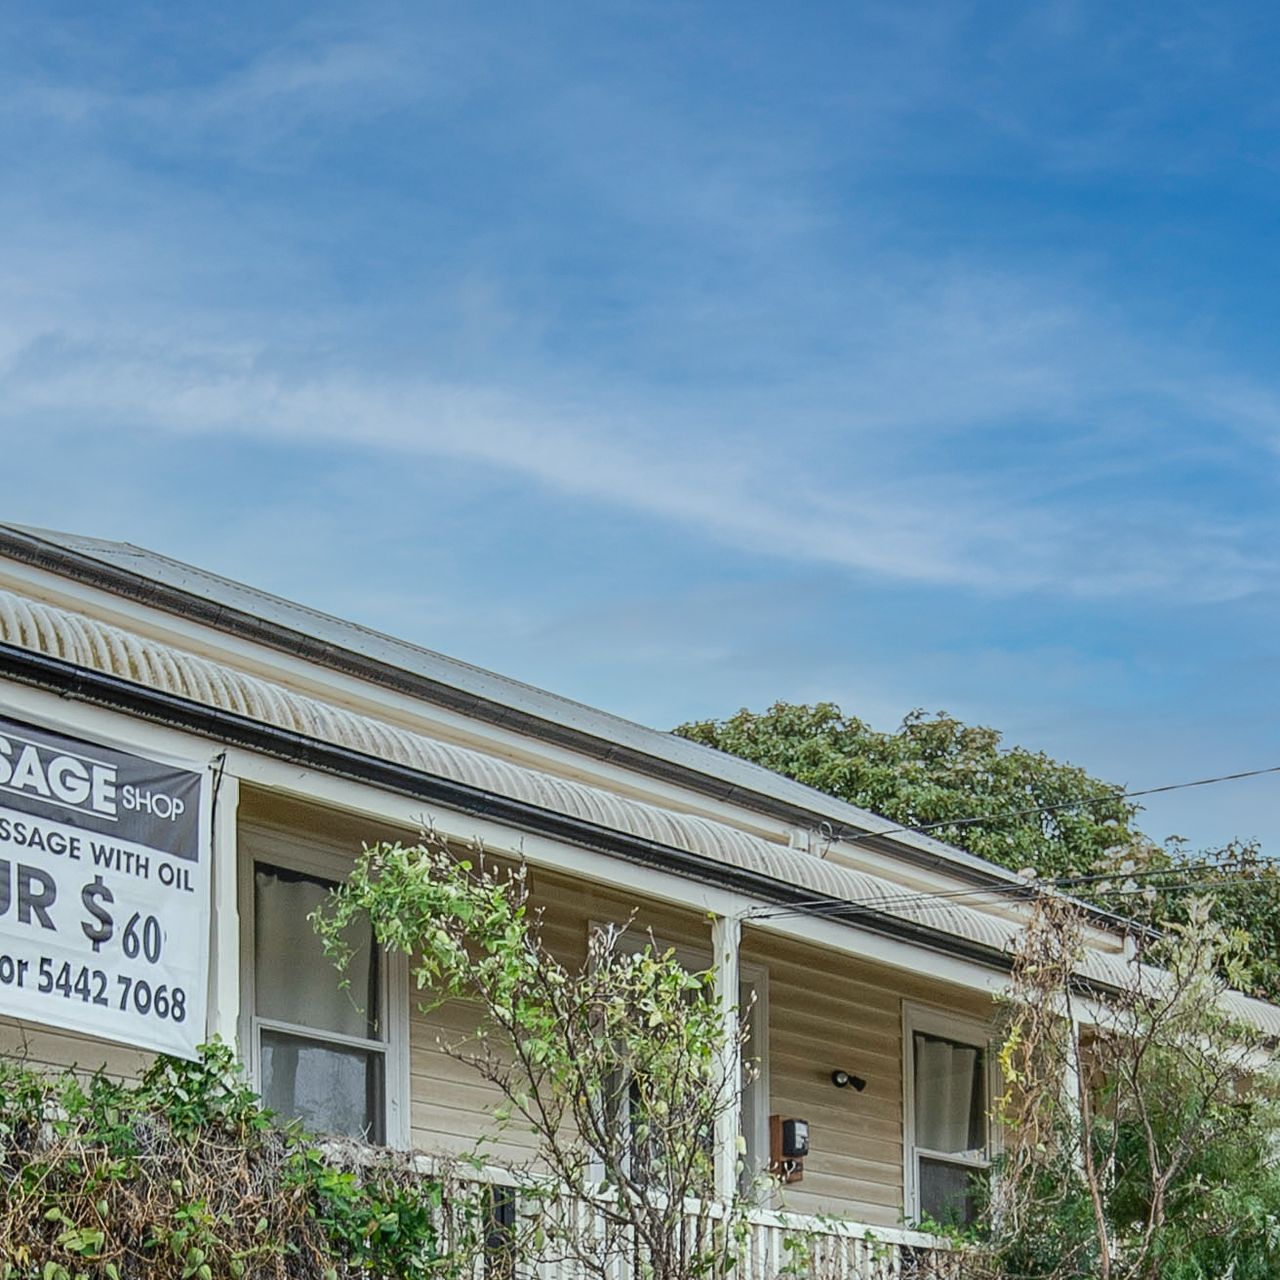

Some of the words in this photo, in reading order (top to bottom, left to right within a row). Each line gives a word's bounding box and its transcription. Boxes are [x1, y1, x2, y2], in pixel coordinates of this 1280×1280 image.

[122, 784, 185, 822] SHOP
[90, 841, 149, 879] WITH
[158, 863, 195, 893] OIL
[38, 957, 109, 1009] 5442
[118, 975, 186, 1024] 7068
